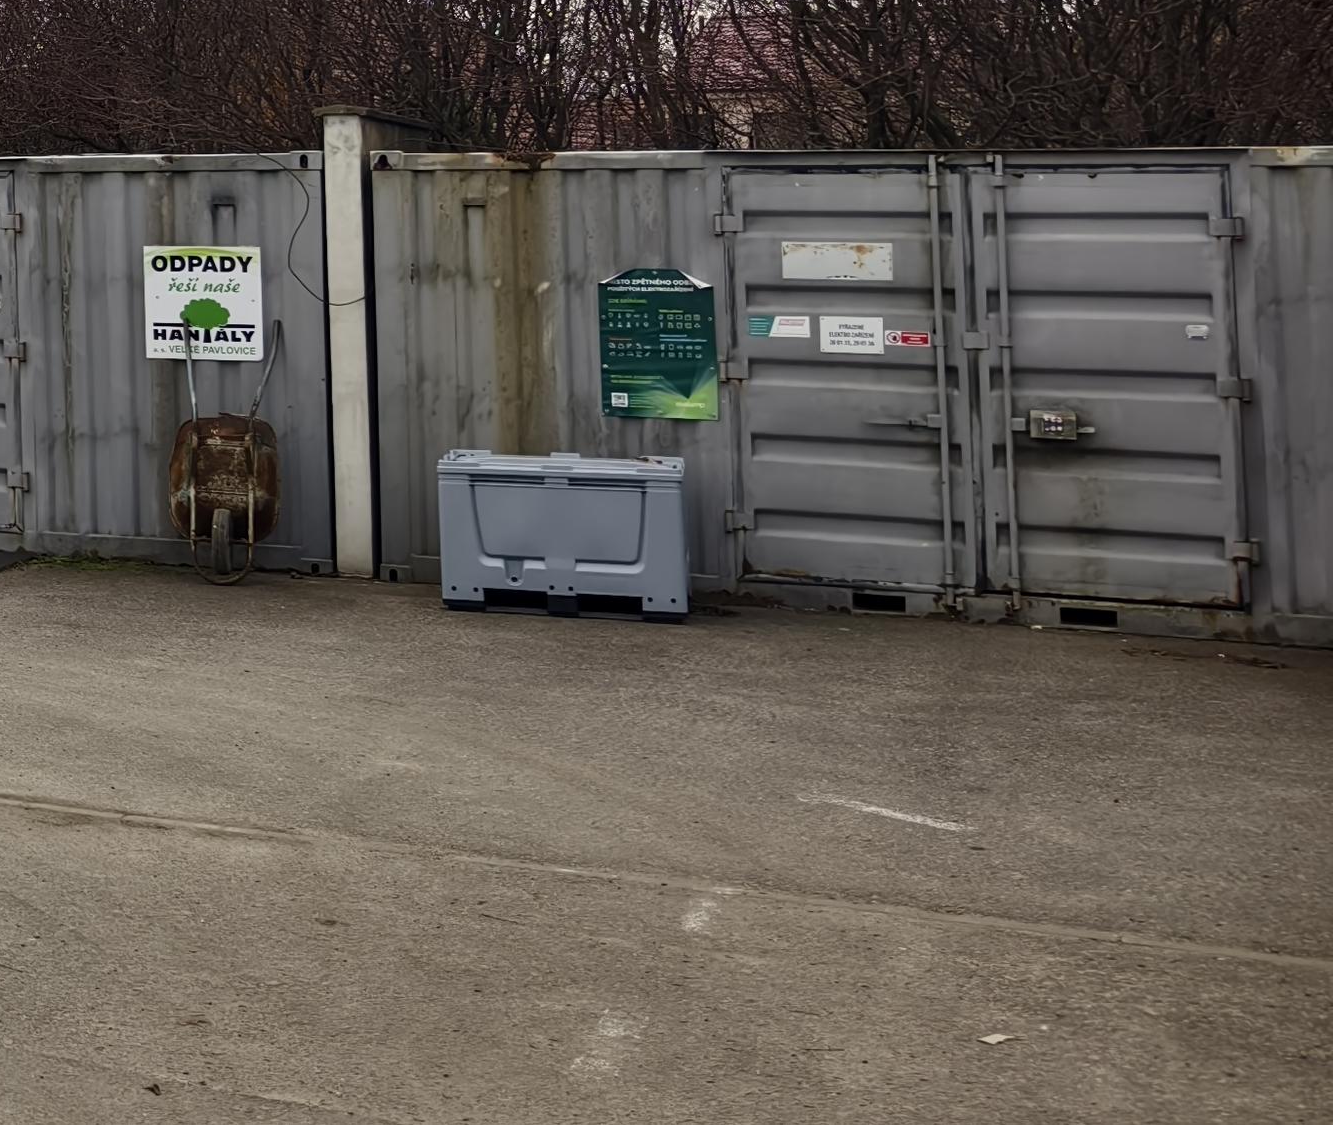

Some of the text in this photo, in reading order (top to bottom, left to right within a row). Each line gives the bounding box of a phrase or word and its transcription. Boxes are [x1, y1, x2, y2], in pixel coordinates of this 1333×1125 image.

[151, 255, 253, 273] ODPADY
[168, 277, 240, 293] řeší naše
[202, 346, 256, 355] PAVLOVICE
